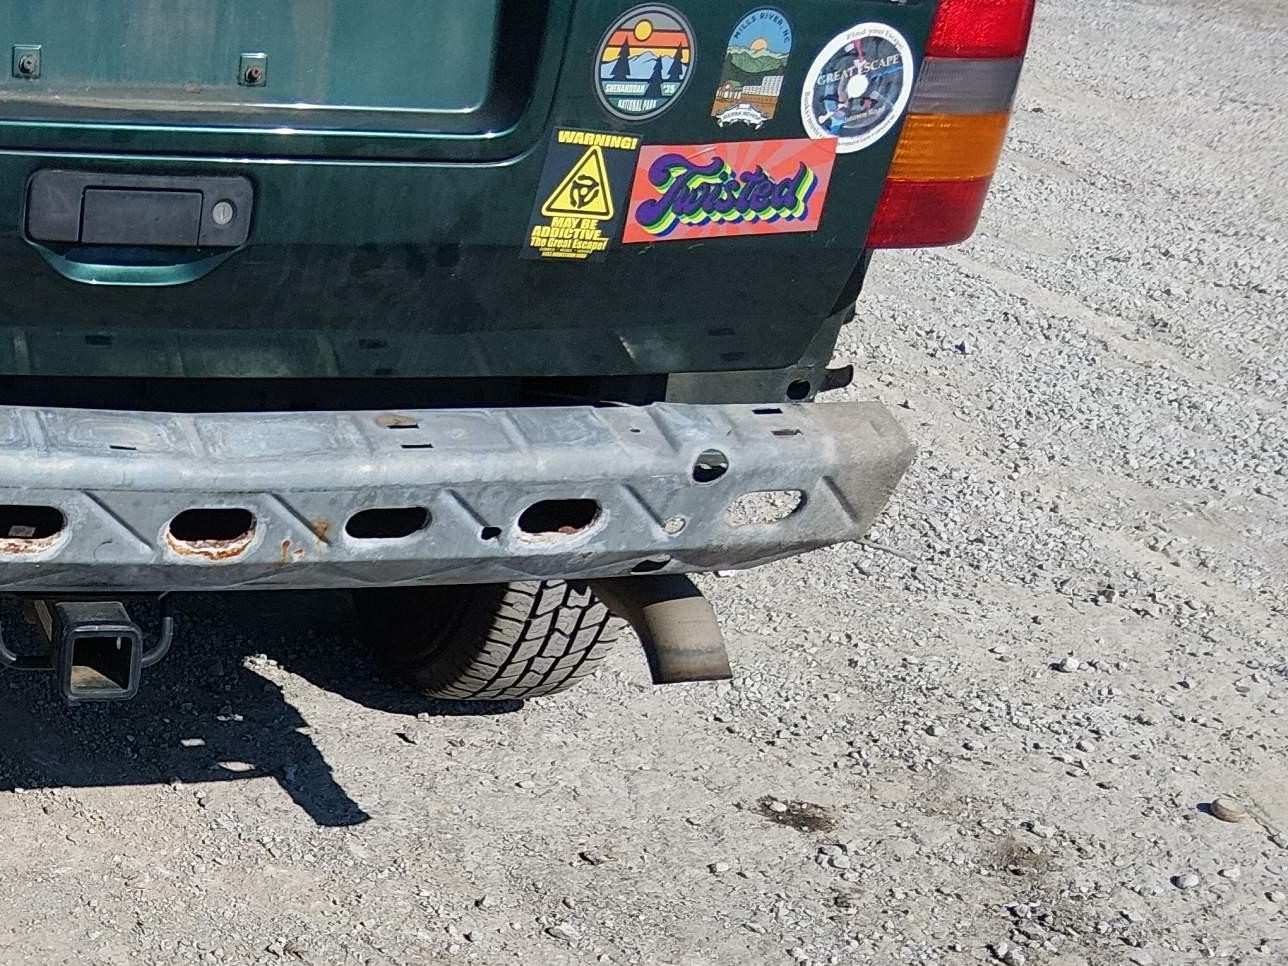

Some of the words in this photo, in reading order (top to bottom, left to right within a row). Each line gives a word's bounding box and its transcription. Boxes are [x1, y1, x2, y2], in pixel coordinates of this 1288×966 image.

[734, 15, 757, 39] MILLS
[817, 65, 856, 86] GREAT
[857, 53, 901, 75] ESCAPE
[558, 130, 640, 150] WARNING!
[635, 153, 818, 236] Twisted
[551, 216, 579, 229] MAY
[580, 218, 599, 230] BE
[530, 236, 547, 247] The
[547, 238, 571, 249] Great
